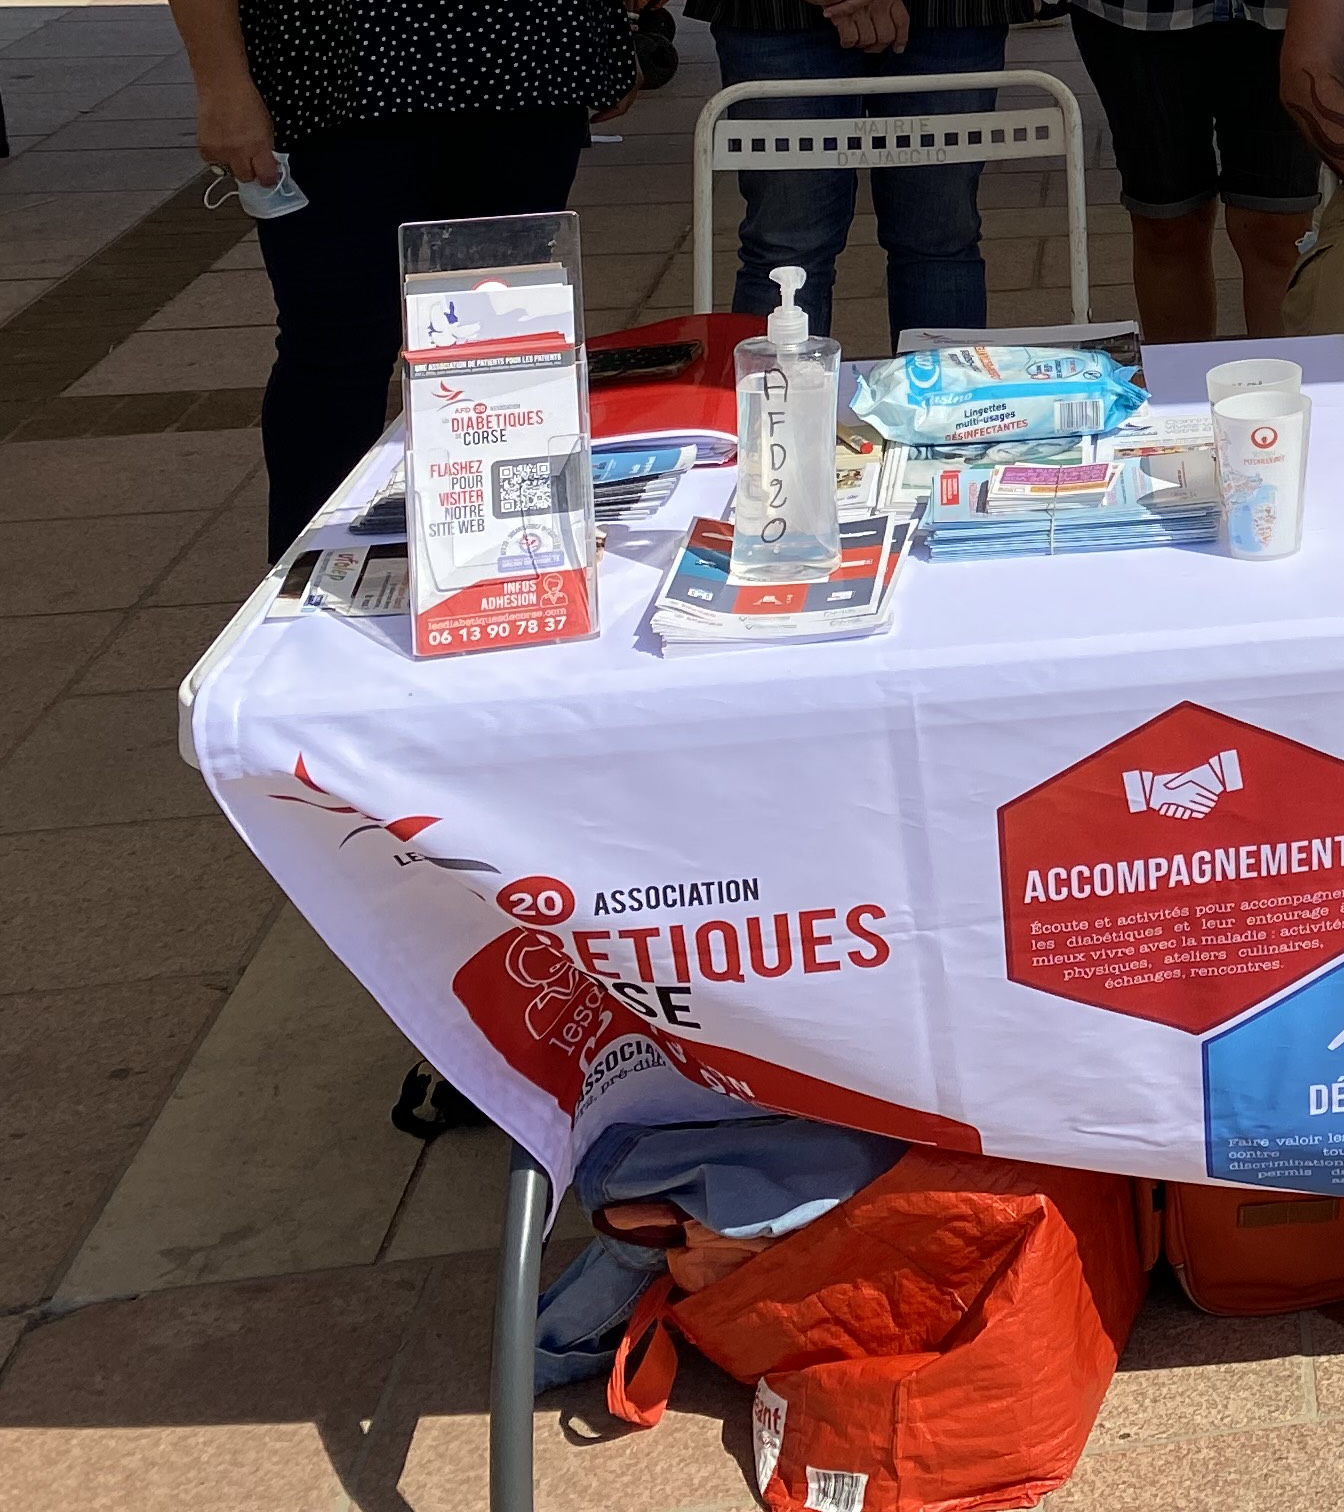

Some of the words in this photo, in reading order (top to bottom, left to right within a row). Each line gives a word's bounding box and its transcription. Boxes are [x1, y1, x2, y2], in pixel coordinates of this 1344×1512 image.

[955, 410, 1017, 430] multi-usages
[964, 402, 1007, 419] Lingettes
[451, 409, 544, 433] DIABETIQUES
[944, 419, 1030, 442] DÉSINFECTANTES
[463, 428, 508, 447] CORSE
[430, 459, 483, 479] FLASHEZ
[451, 475, 483, 490] POUR
[439, 489, 484, 507] VISITER
[444, 504, 485, 522] NOTRE
[429, 522, 455, 537] SITE
[459, 519, 485, 535] WEB
[503, 580, 537, 594] INFOS
[428, 631, 452, 646] 06
[459, 627, 481, 641] 13
[487, 623, 510, 638] 90
[516, 619, 539, 635] 78
[544, 616, 567, 632] 37
[509, 890, 564, 916] 20
[594, 878, 759, 916] ASSOCIATION
[572, 904, 891, 985] ETIQUES
